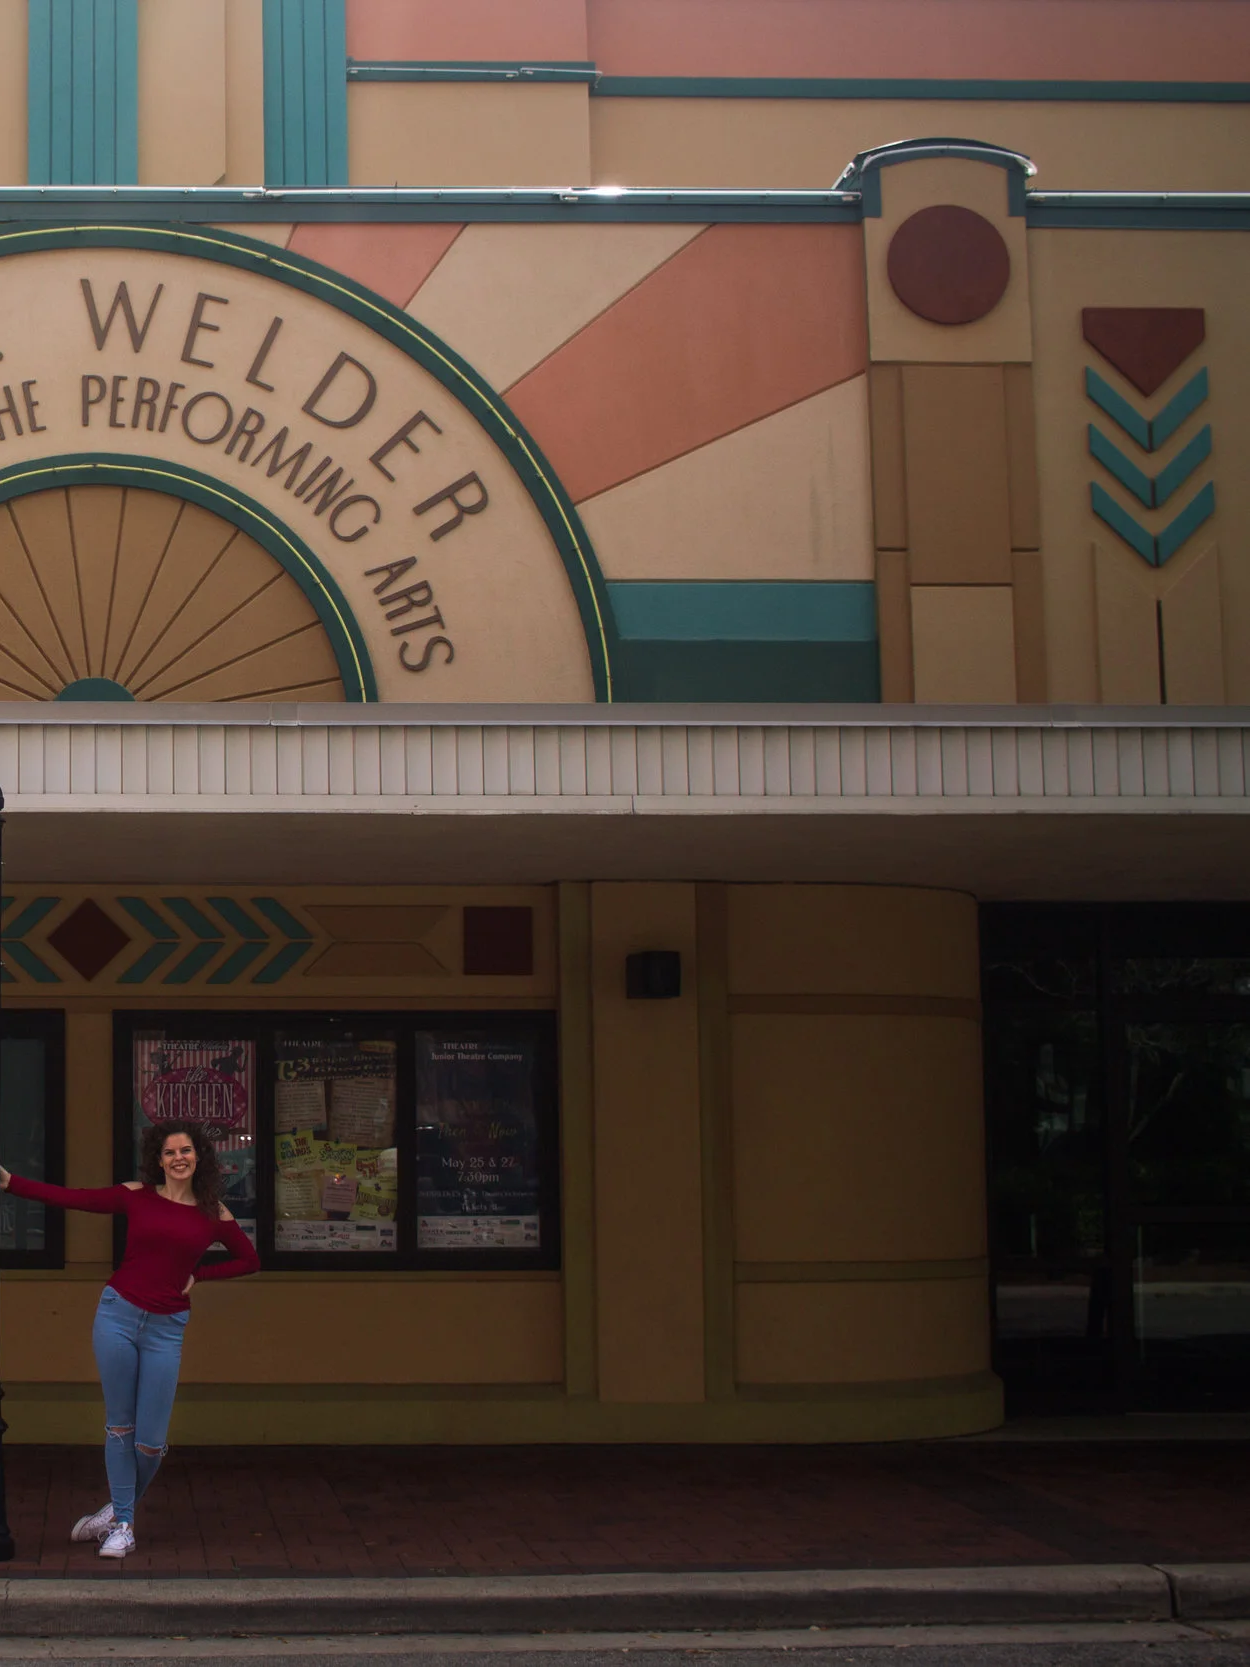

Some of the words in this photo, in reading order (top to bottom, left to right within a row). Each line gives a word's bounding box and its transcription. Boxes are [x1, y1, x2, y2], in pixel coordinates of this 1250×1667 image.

[79, 278, 491, 543] WELDER
[80, 373, 383, 544] PERFORMING
[363, 554, 455, 674] ARTS
[430, 1052, 455, 1061] Junior
[457, 1052, 486, 1060] Theatre
[488, 1052, 524, 1062] Company
[185, 1065, 208, 1082] the
[155, 1083, 234, 1118] KITCHEN
[441, 1157, 466, 1169] May
[469, 1156, 485, 1168] 25
